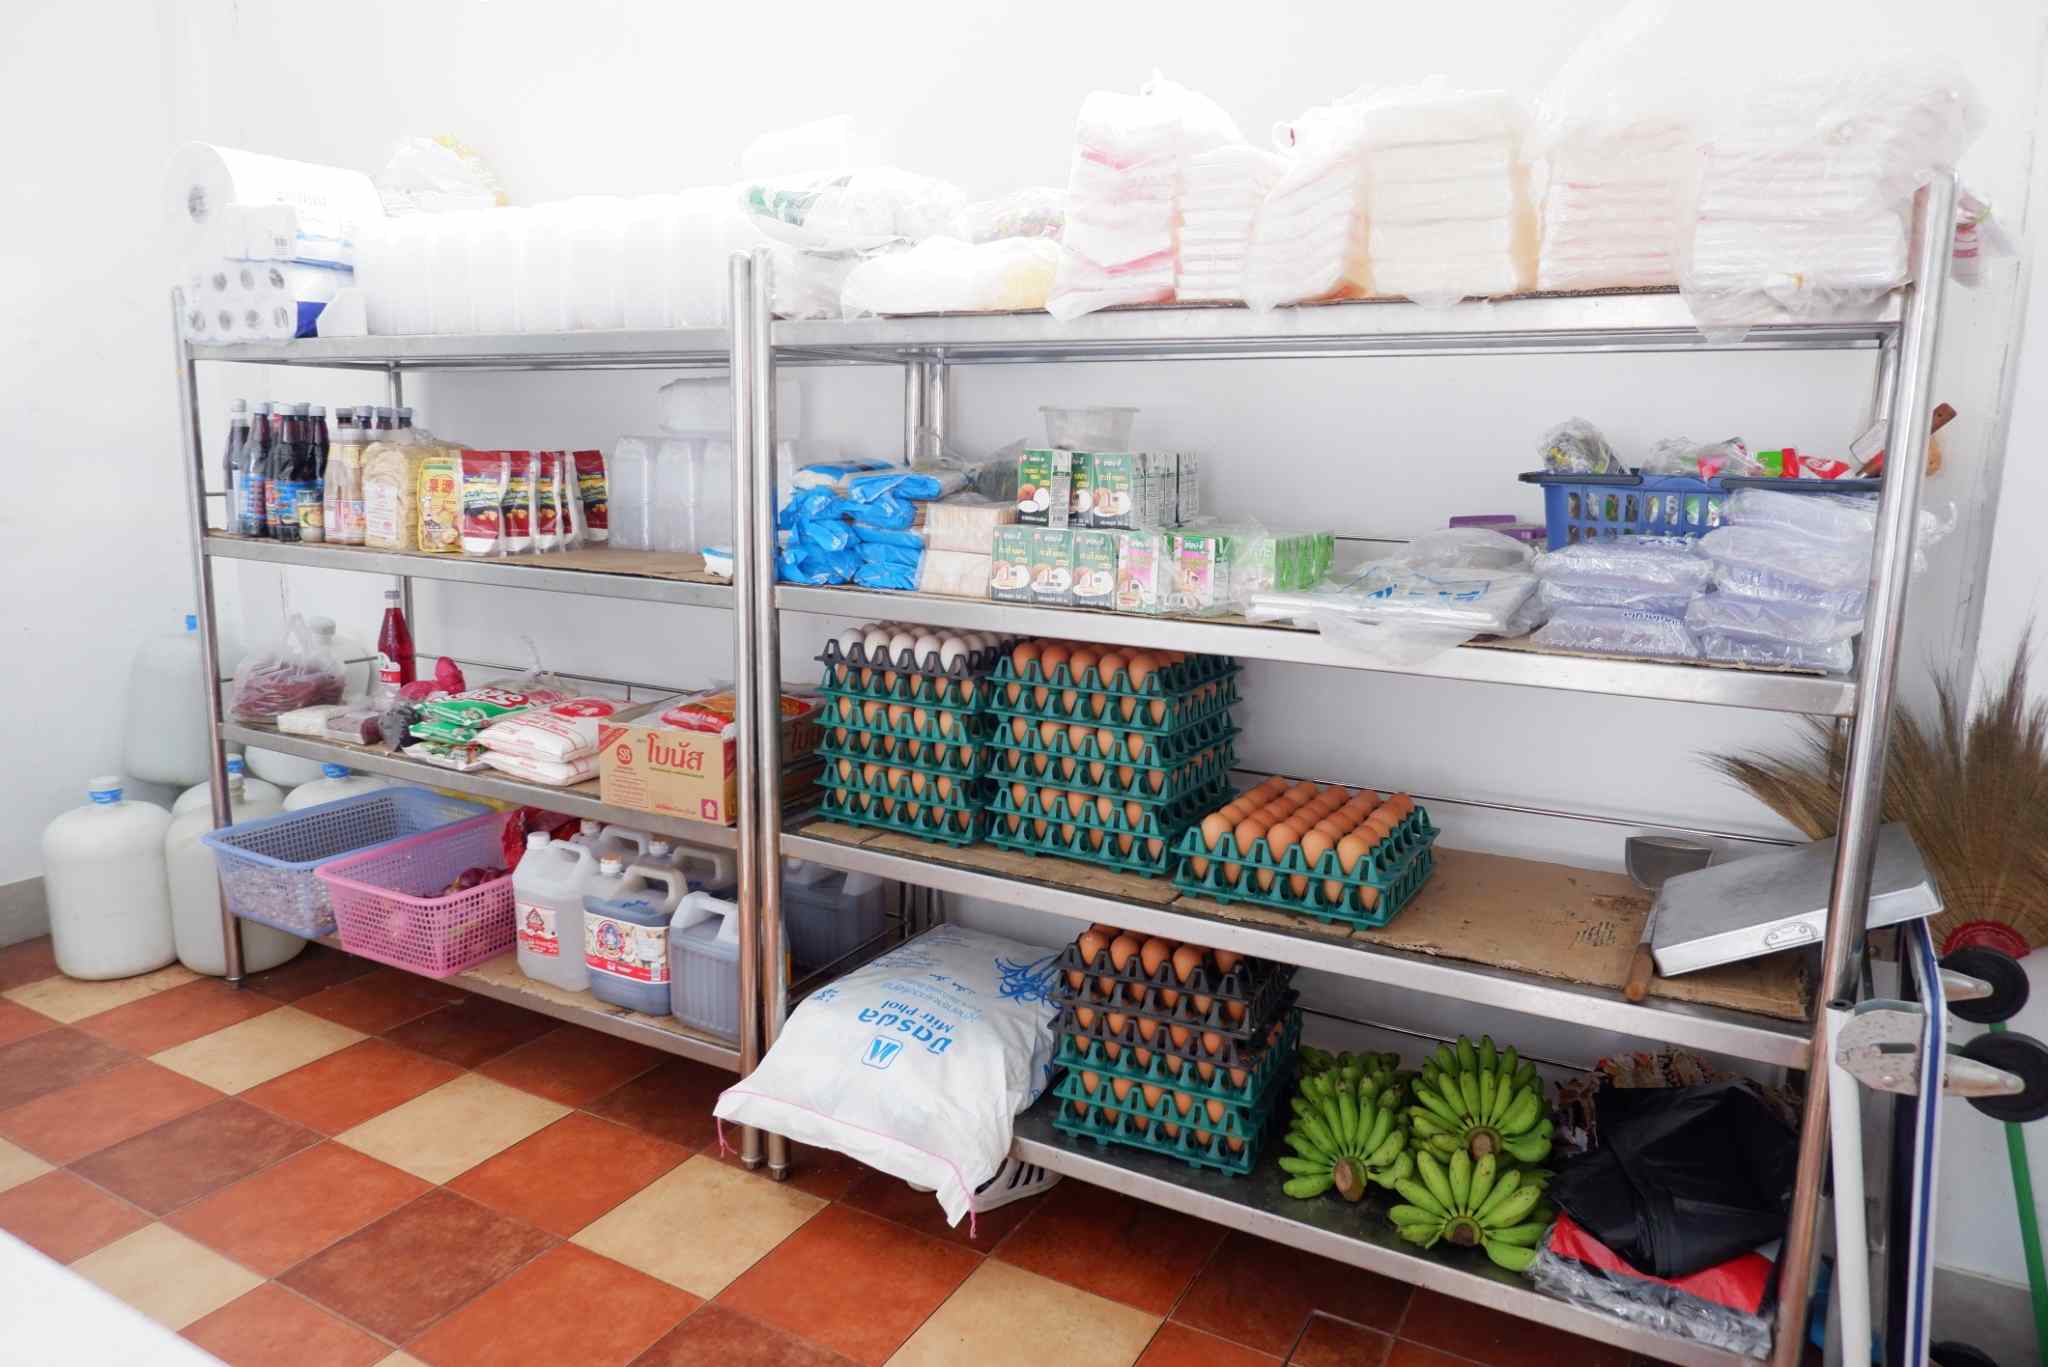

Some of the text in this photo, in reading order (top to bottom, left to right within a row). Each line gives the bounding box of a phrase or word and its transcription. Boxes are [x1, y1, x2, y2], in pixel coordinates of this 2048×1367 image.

[647, 732, 704, 771] โบนัส
[880, 1000, 918, 1017] Phol
[920, 1012, 954, 1033] Mitr
[858, 1007, 953, 1054] มิตรผล
